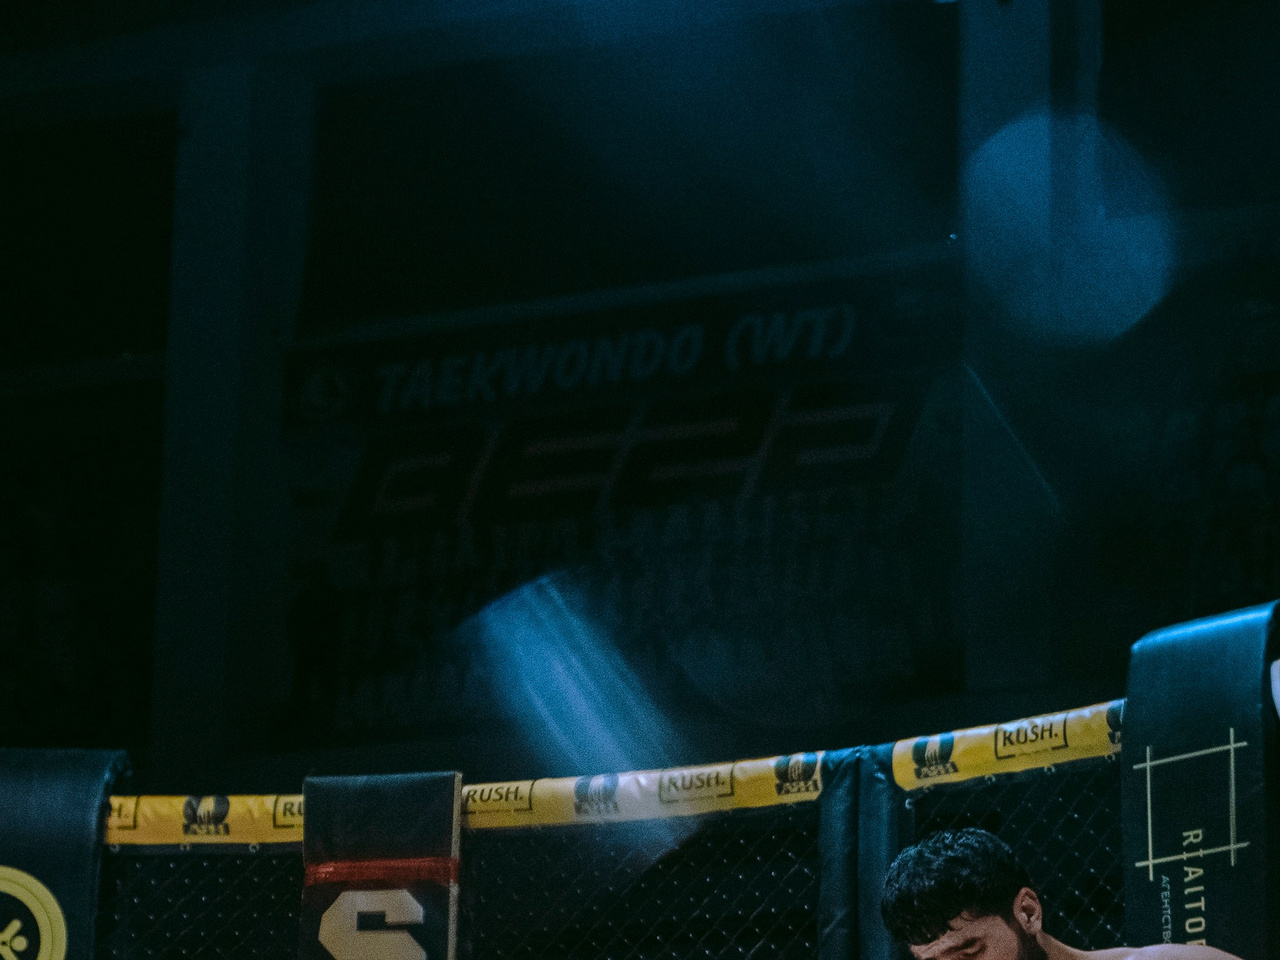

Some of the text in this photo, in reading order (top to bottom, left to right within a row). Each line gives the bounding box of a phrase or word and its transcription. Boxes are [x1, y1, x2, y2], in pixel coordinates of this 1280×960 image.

[374, 303, 858, 414] TAEKWONDO (WT)
[1003, 722, 1058, 747] RUSH.
[668, 771, 725, 792] RUSH.
[465, 786, 524, 804] RUSH.
